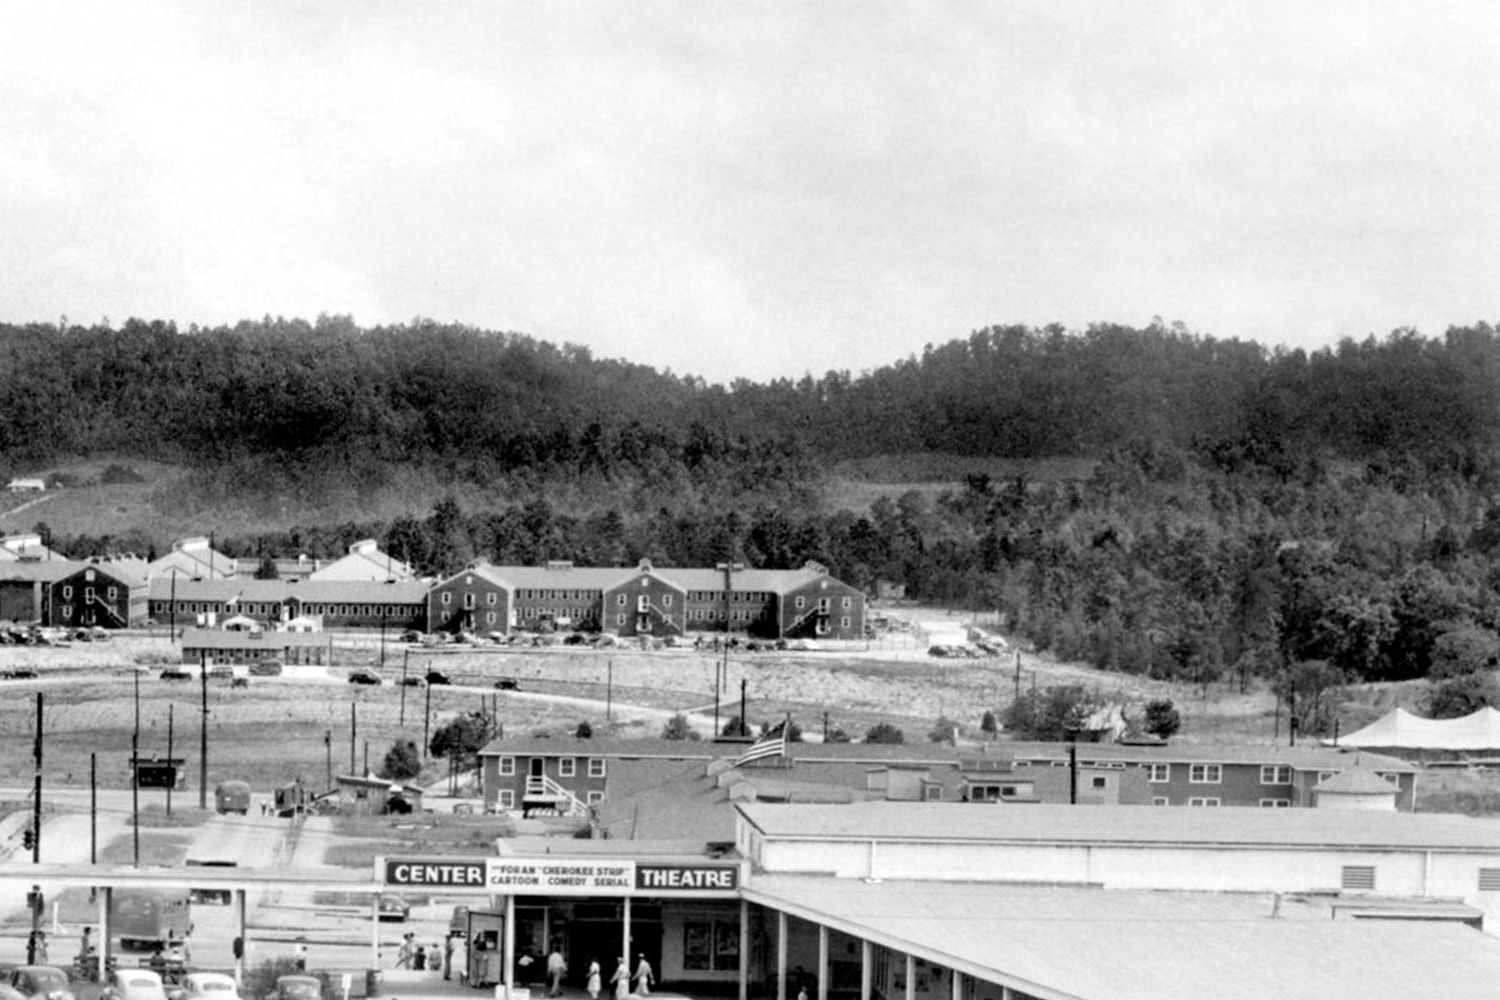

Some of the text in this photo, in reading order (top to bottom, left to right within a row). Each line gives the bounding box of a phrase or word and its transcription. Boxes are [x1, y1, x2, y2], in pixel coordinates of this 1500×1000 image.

[394, 864, 483, 884] CENTER
[491, 876, 629, 887] CARTOON COMEDY SERIAL
[640, 869, 733, 887] THEATRE
